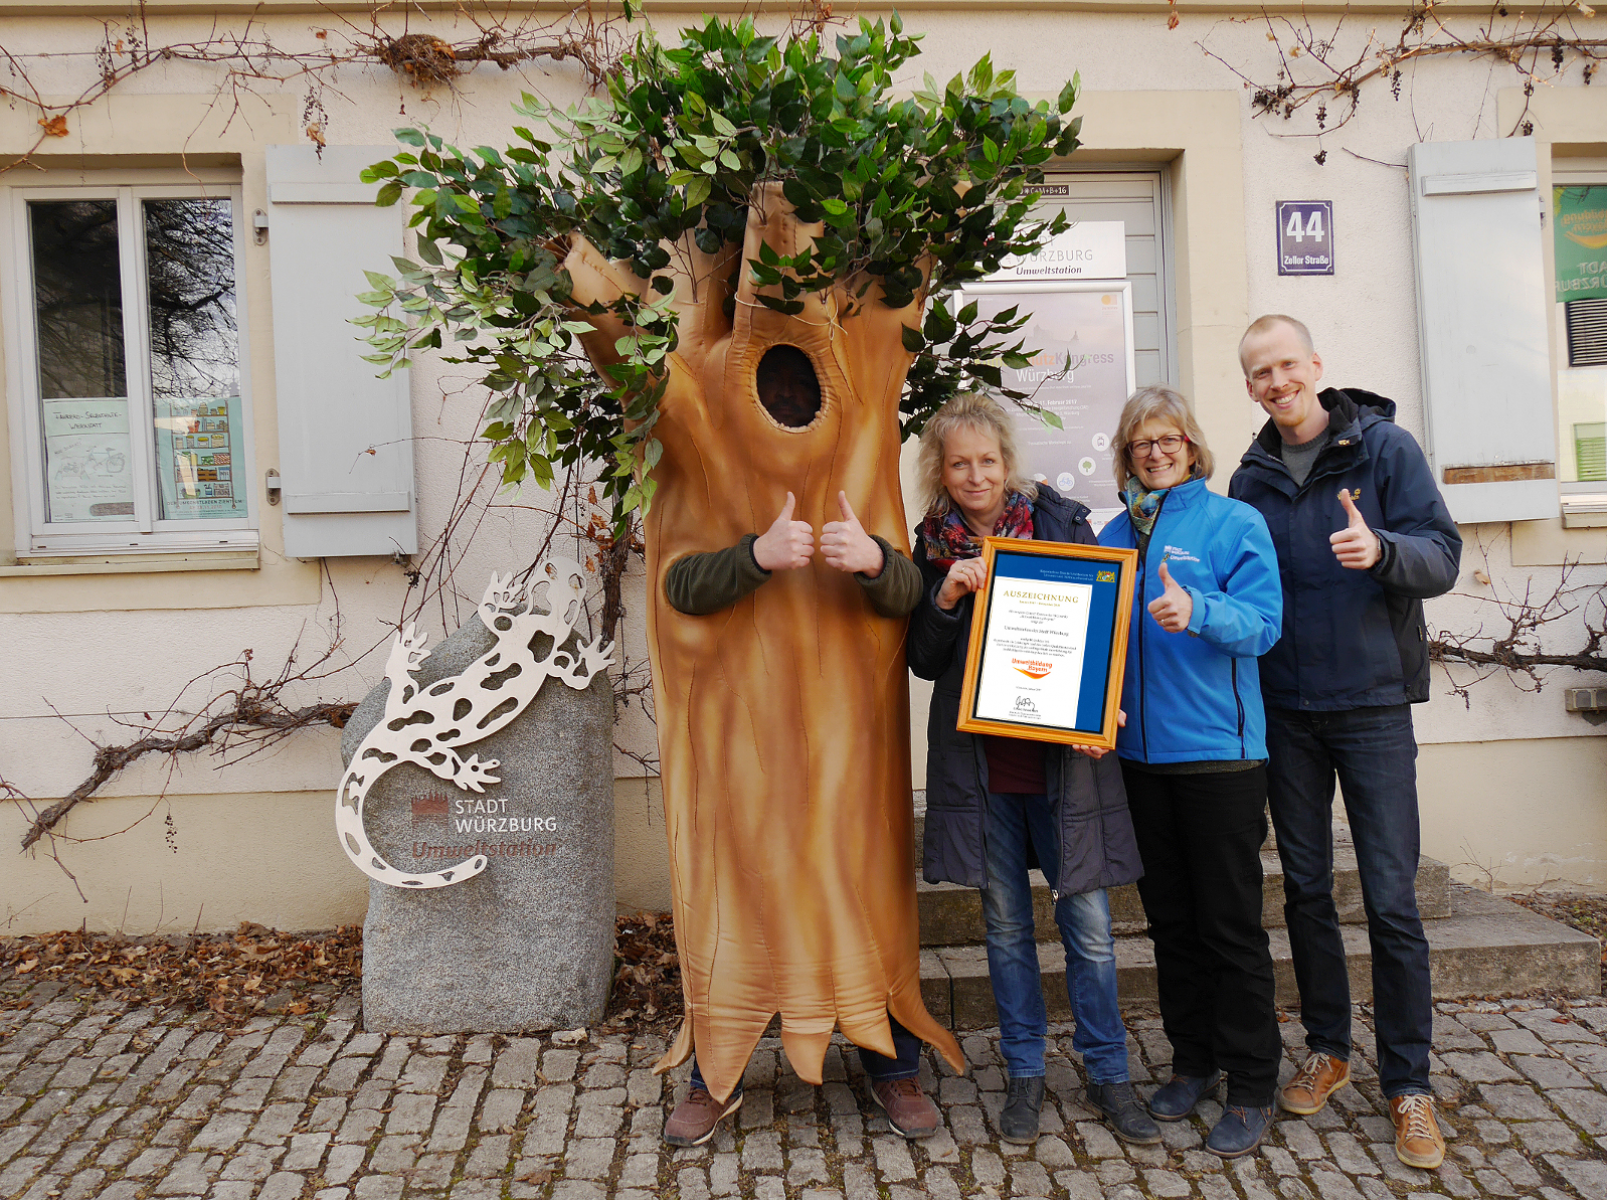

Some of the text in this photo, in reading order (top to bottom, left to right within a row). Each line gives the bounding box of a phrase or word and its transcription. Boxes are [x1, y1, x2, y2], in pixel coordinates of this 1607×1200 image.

[1286, 211, 1325, 243] 44
[1284, 255, 1329, 265] Zeller Straße
[1016, 265, 1082, 276] Umweltstation
[1003, 590, 1079, 604] AUSZEICHNUNG
[1011, 658, 1053, 669] Umweltbildung
[1028, 665, 1048, 673] Bayern
[455, 798, 508, 814] STADT
[455, 816, 557, 833] WÜRZBURG
[412, 838, 558, 859] Umweltstation
